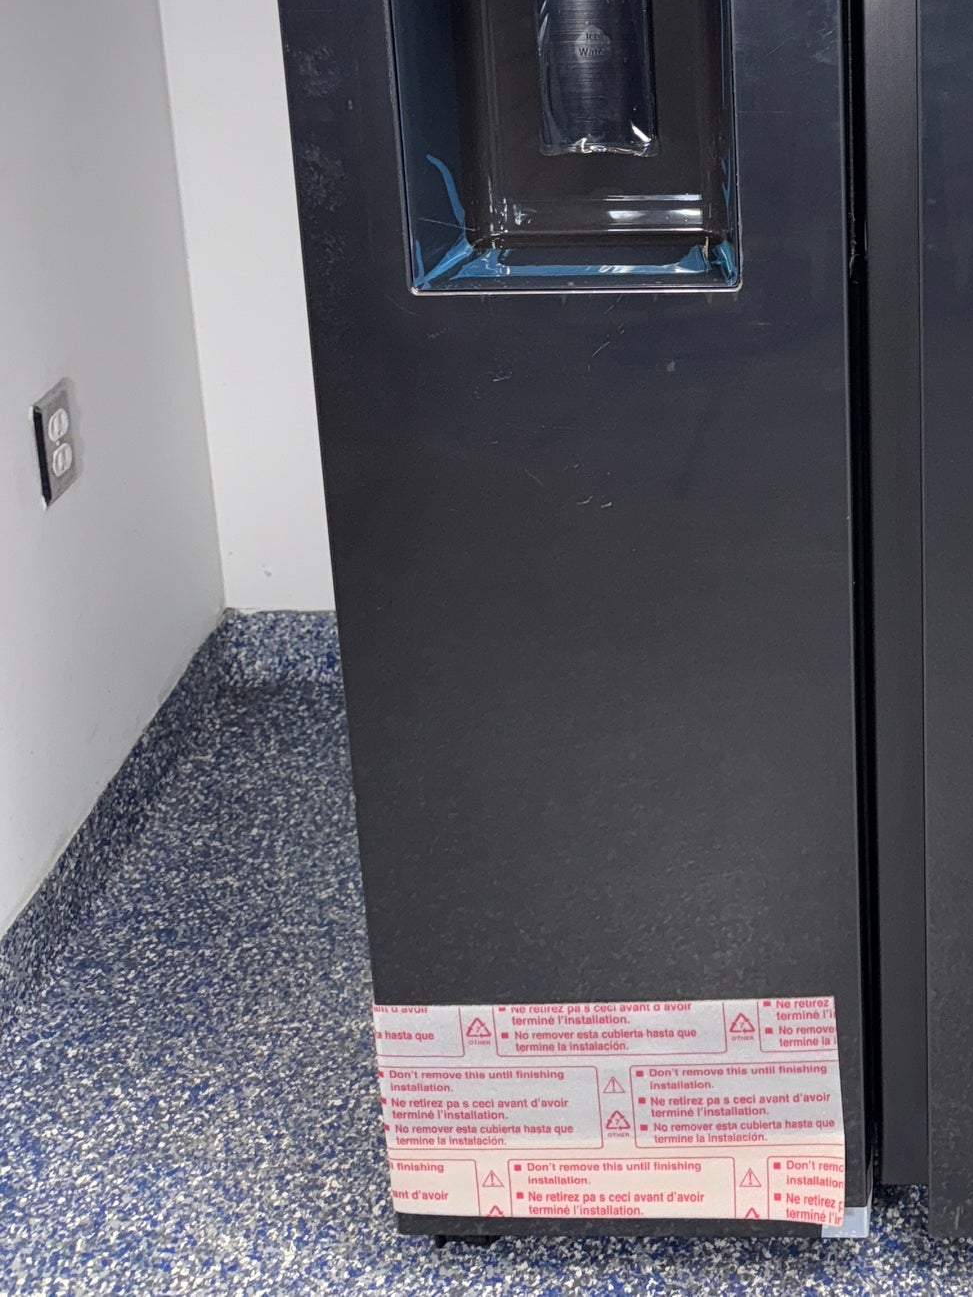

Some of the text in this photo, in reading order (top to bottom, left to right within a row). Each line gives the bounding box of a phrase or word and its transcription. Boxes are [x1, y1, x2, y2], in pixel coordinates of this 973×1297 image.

[388, 1069, 565, 1080] Don't remove this until finishing
[390, 1081, 453, 1091] installation.
[390, 1098, 406, 1108] Ne
[407, 1098, 443, 1109] retirez
[445, 1100, 461, 1109] pa
[471, 1100, 495, 1109] ceci
[497, 1099, 528, 1108] avant
[530, 1099, 568, 1107] d'avoir
[394, 1124, 574, 1135] No remover esta cubierta hasta que
[396, 1137, 434, 1146] termine
[448, 1137, 507, 1146] instalación.
